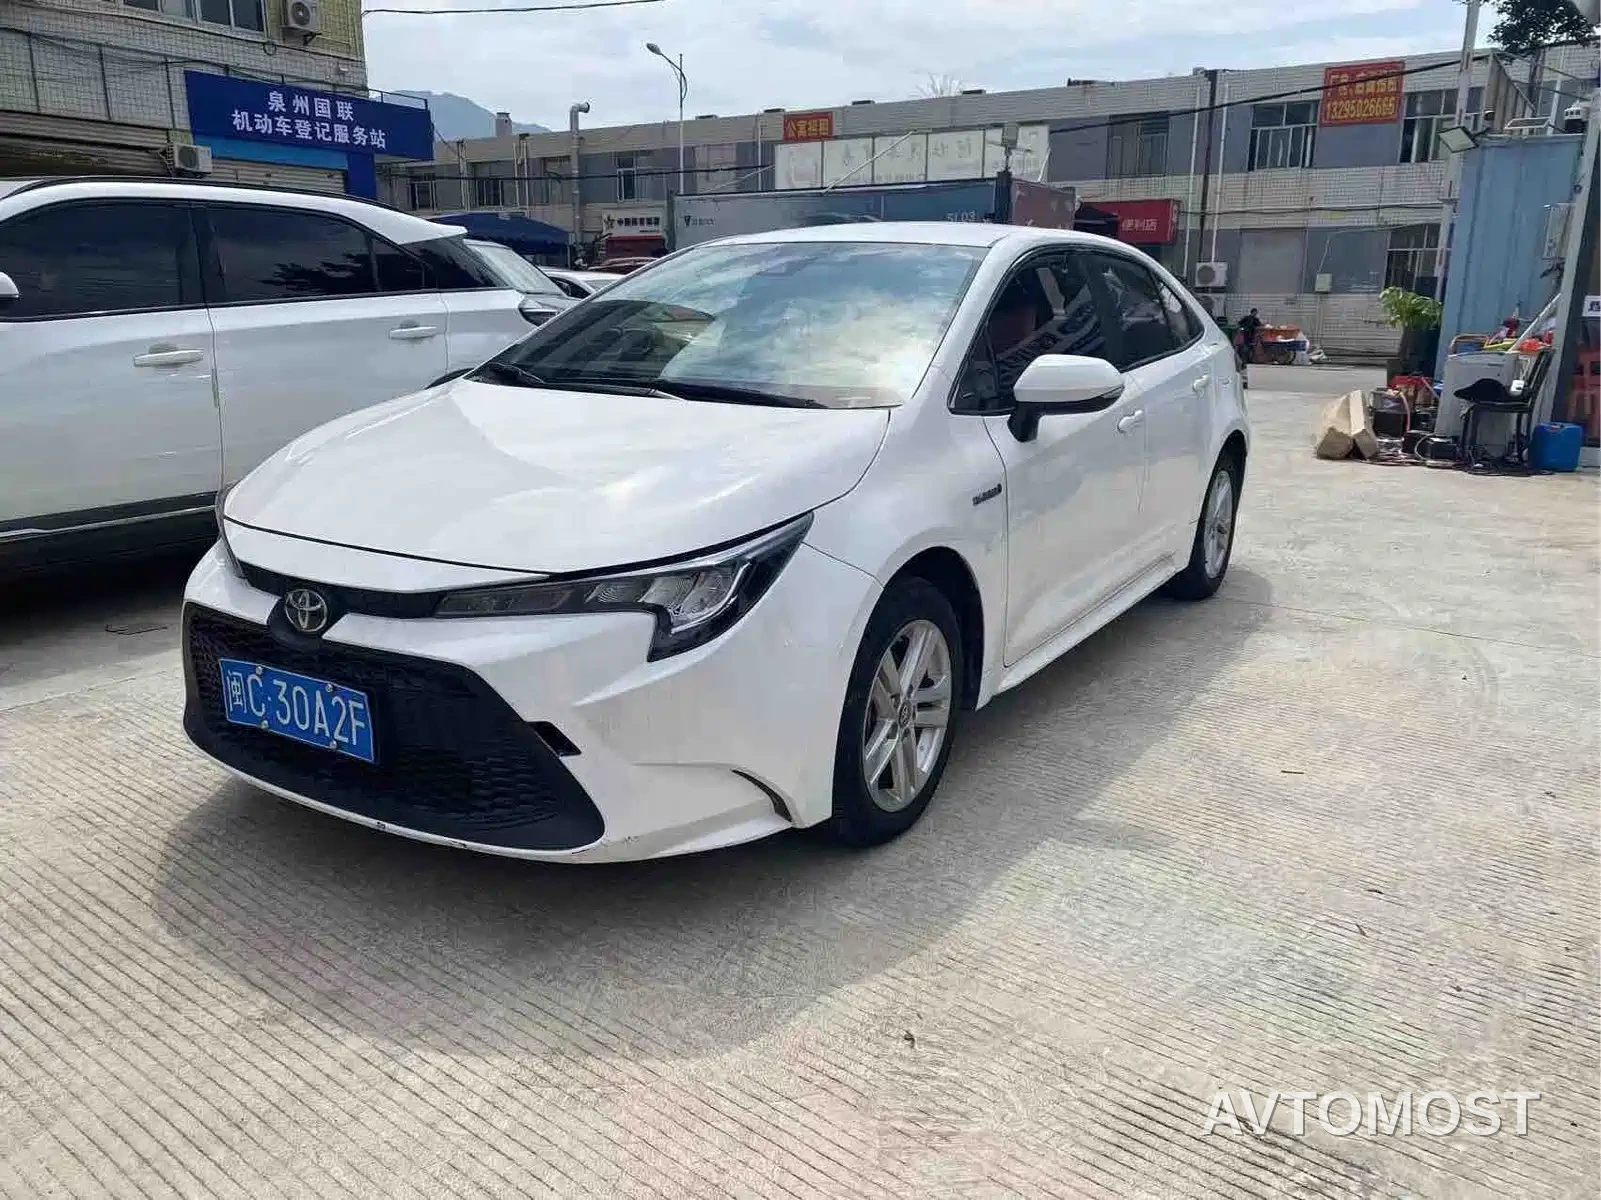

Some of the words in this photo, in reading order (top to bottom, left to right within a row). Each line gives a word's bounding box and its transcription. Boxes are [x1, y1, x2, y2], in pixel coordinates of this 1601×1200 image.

[268, 91, 354, 121] 泉州国联
[232, 109, 386, 148] 机动车登记服务站
